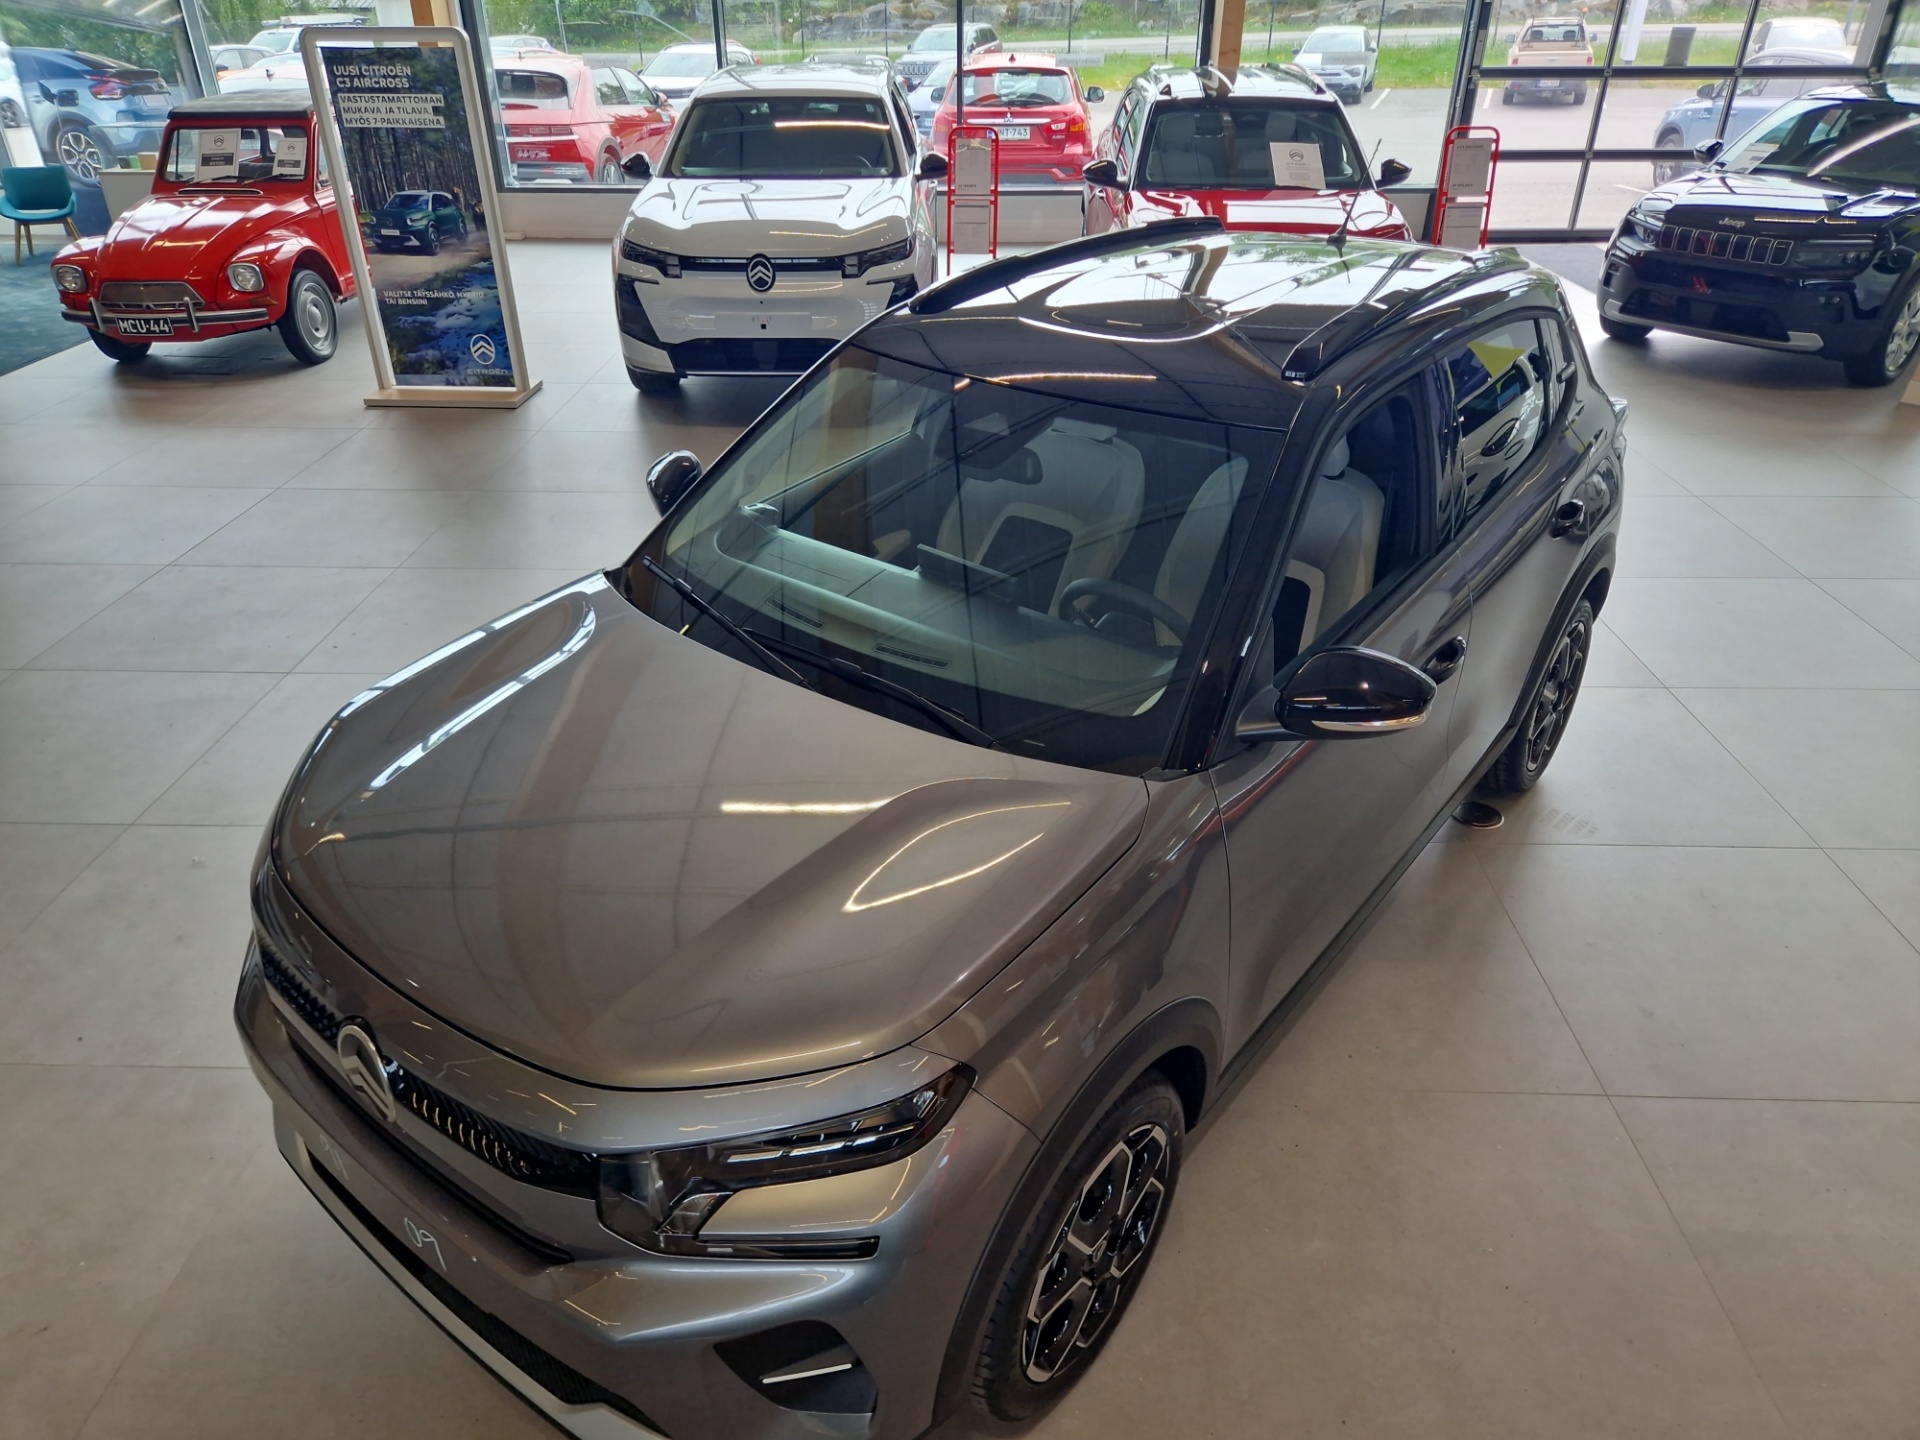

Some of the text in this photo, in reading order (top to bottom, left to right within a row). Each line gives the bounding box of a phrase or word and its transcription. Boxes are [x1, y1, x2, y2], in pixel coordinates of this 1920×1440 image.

[333, 63, 412, 76] UUSI CITROËN
[336, 78, 410, 88] C3 AIRCROSS
[340, 95, 442, 104] VASTUSTAMATTOMAN
[343, 106, 432, 115] MUKAVA JA TILAVA.
[345, 116, 444, 126] MYÖS 7-PAIKKAISENA.
[1719, 217, 1746, 228] Jeep
[118, 319, 170, 333] MCU-44
